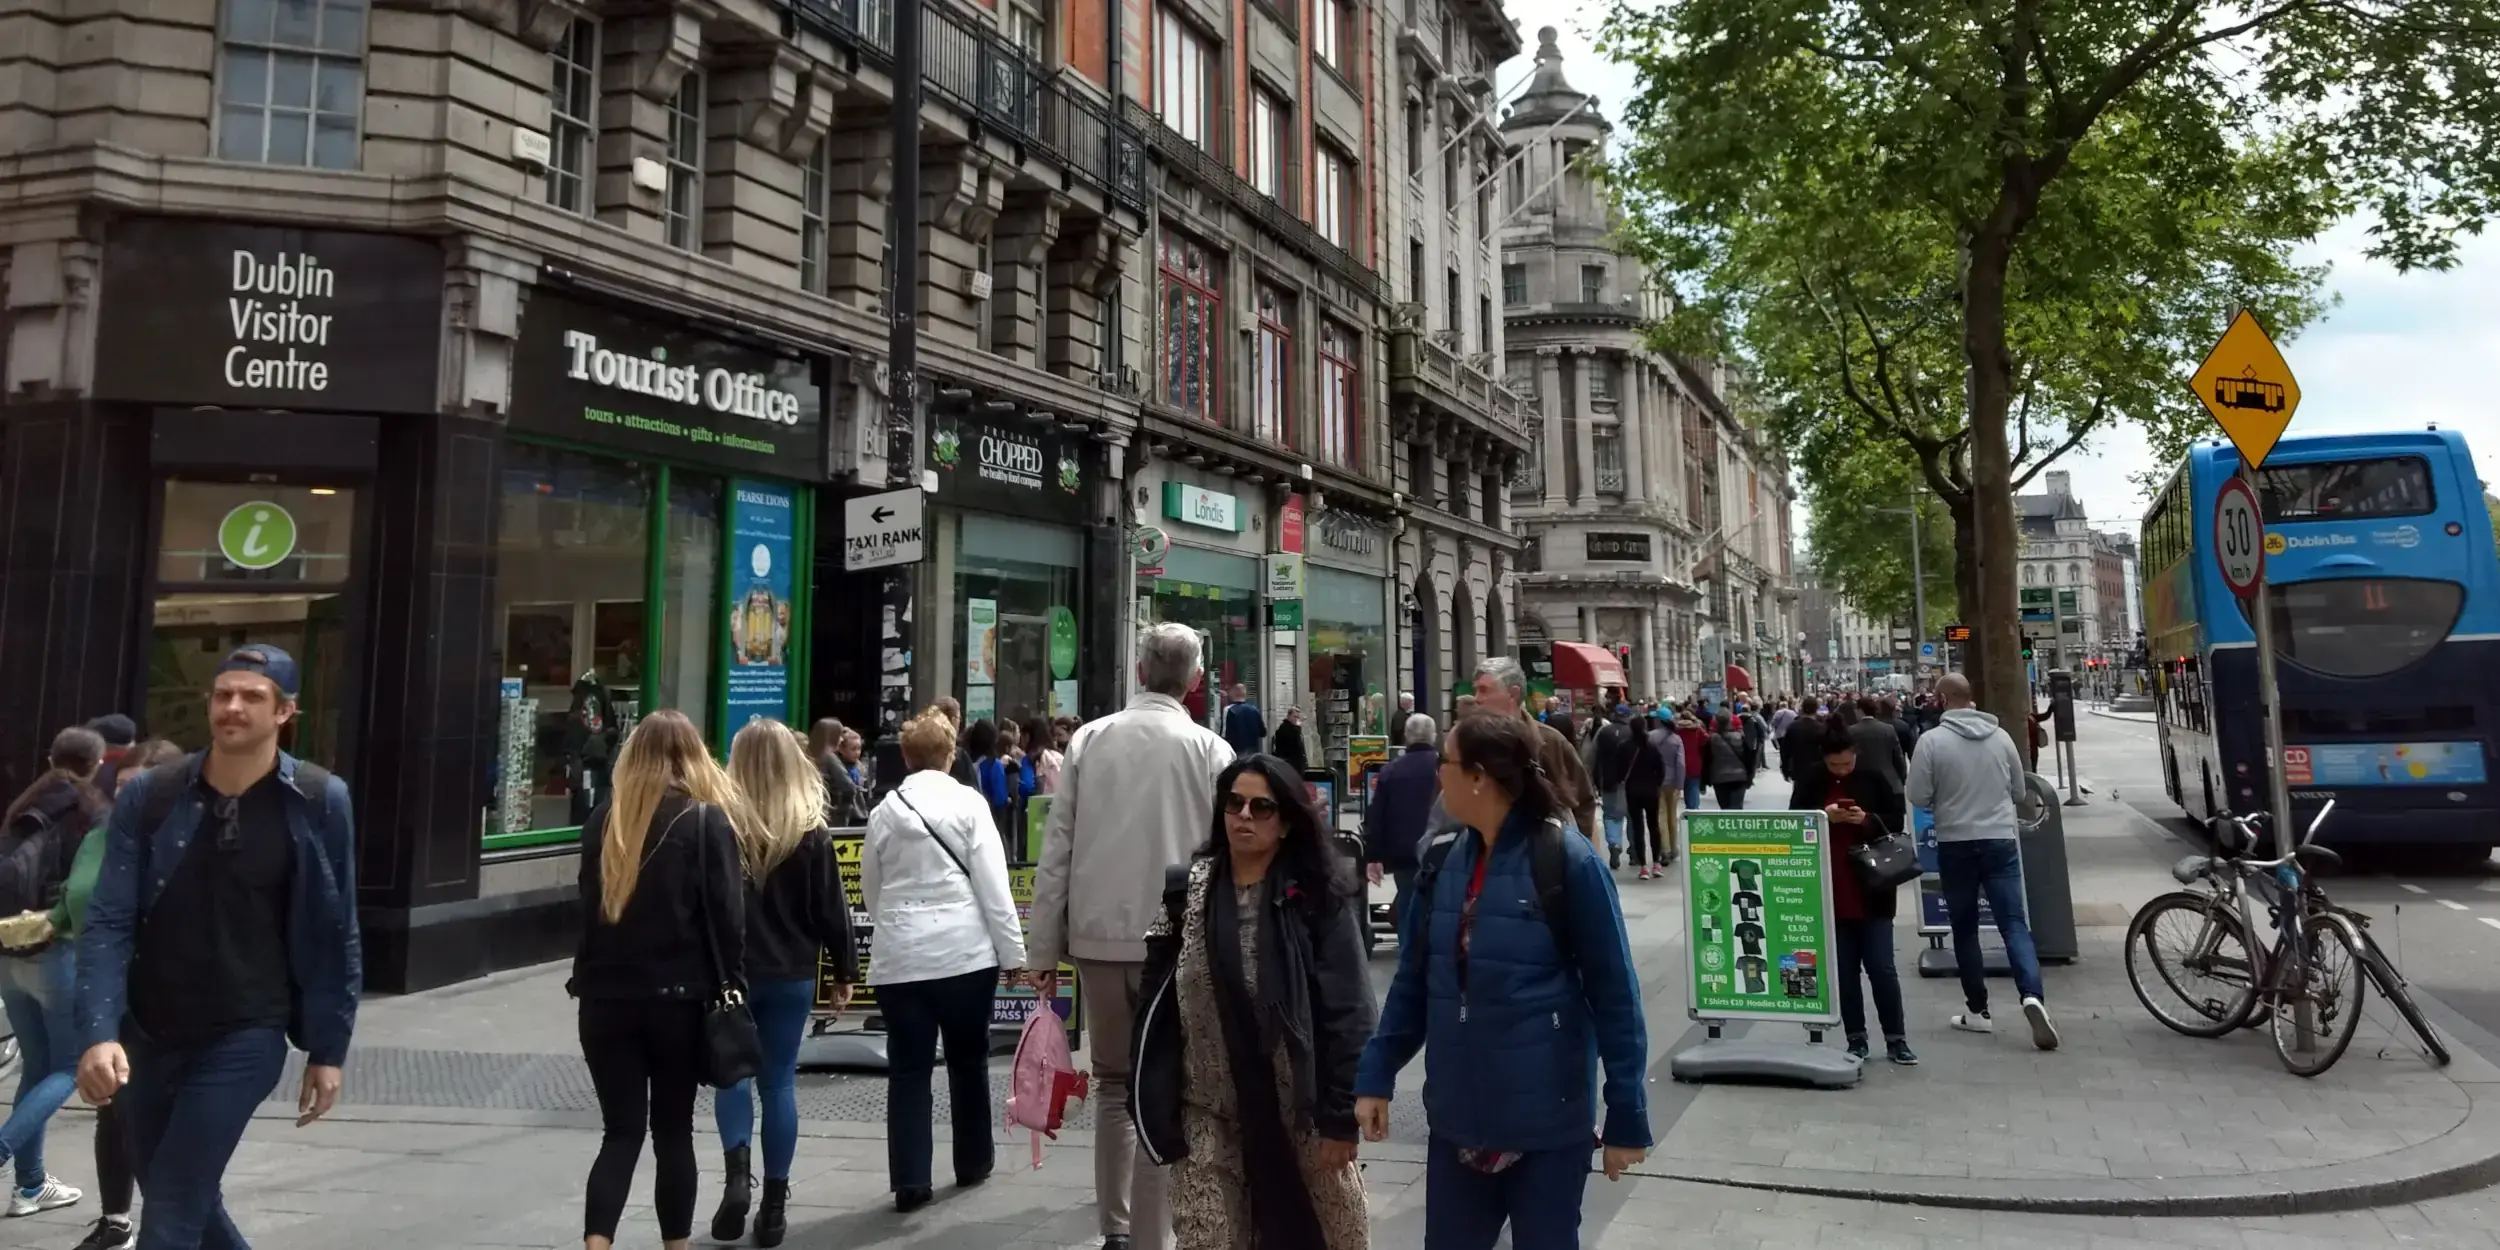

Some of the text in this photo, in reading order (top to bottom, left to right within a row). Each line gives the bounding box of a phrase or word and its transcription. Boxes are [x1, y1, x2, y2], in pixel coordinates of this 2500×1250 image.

[233, 250, 334, 299] Dublin
[229, 297, 333, 346] Visitor
[225, 345, 328, 391] Centre
[564, 329, 798, 425] Tourist Office
[584, 405, 775, 455] tours attractions gifts information
[979, 435, 1043, 473] CHOPPED
[979, 466, 989, 478] the
[989, 467, 1008, 485] healthy
[1020, 476, 1042, 491] company
[1195, 498, 1224, 524] Londis
[847, 527, 922, 551] TAXI RANK
[2225, 507, 2250, 557] 30
[2288, 534, 2357, 548] Dublin Bus
[2231, 563, 2251, 579] km/h
[1767, 858, 1812, 866] IRISH GIFTS
[1773, 869, 1816, 878] JEWELLERY
[1773, 885, 1804, 895] Magnets
[1780, 914, 1814, 923] Key Rings
[1701, 974, 1727, 984] IRELAND
[994, 999, 1018, 1010] BUY
[1708, 998, 1729, 1006] Shirts
[1746, 1000, 1776, 1008] Hoodies
[1777, 1000, 1790, 1008] €20
[994, 1010, 1022, 1020] PASS
